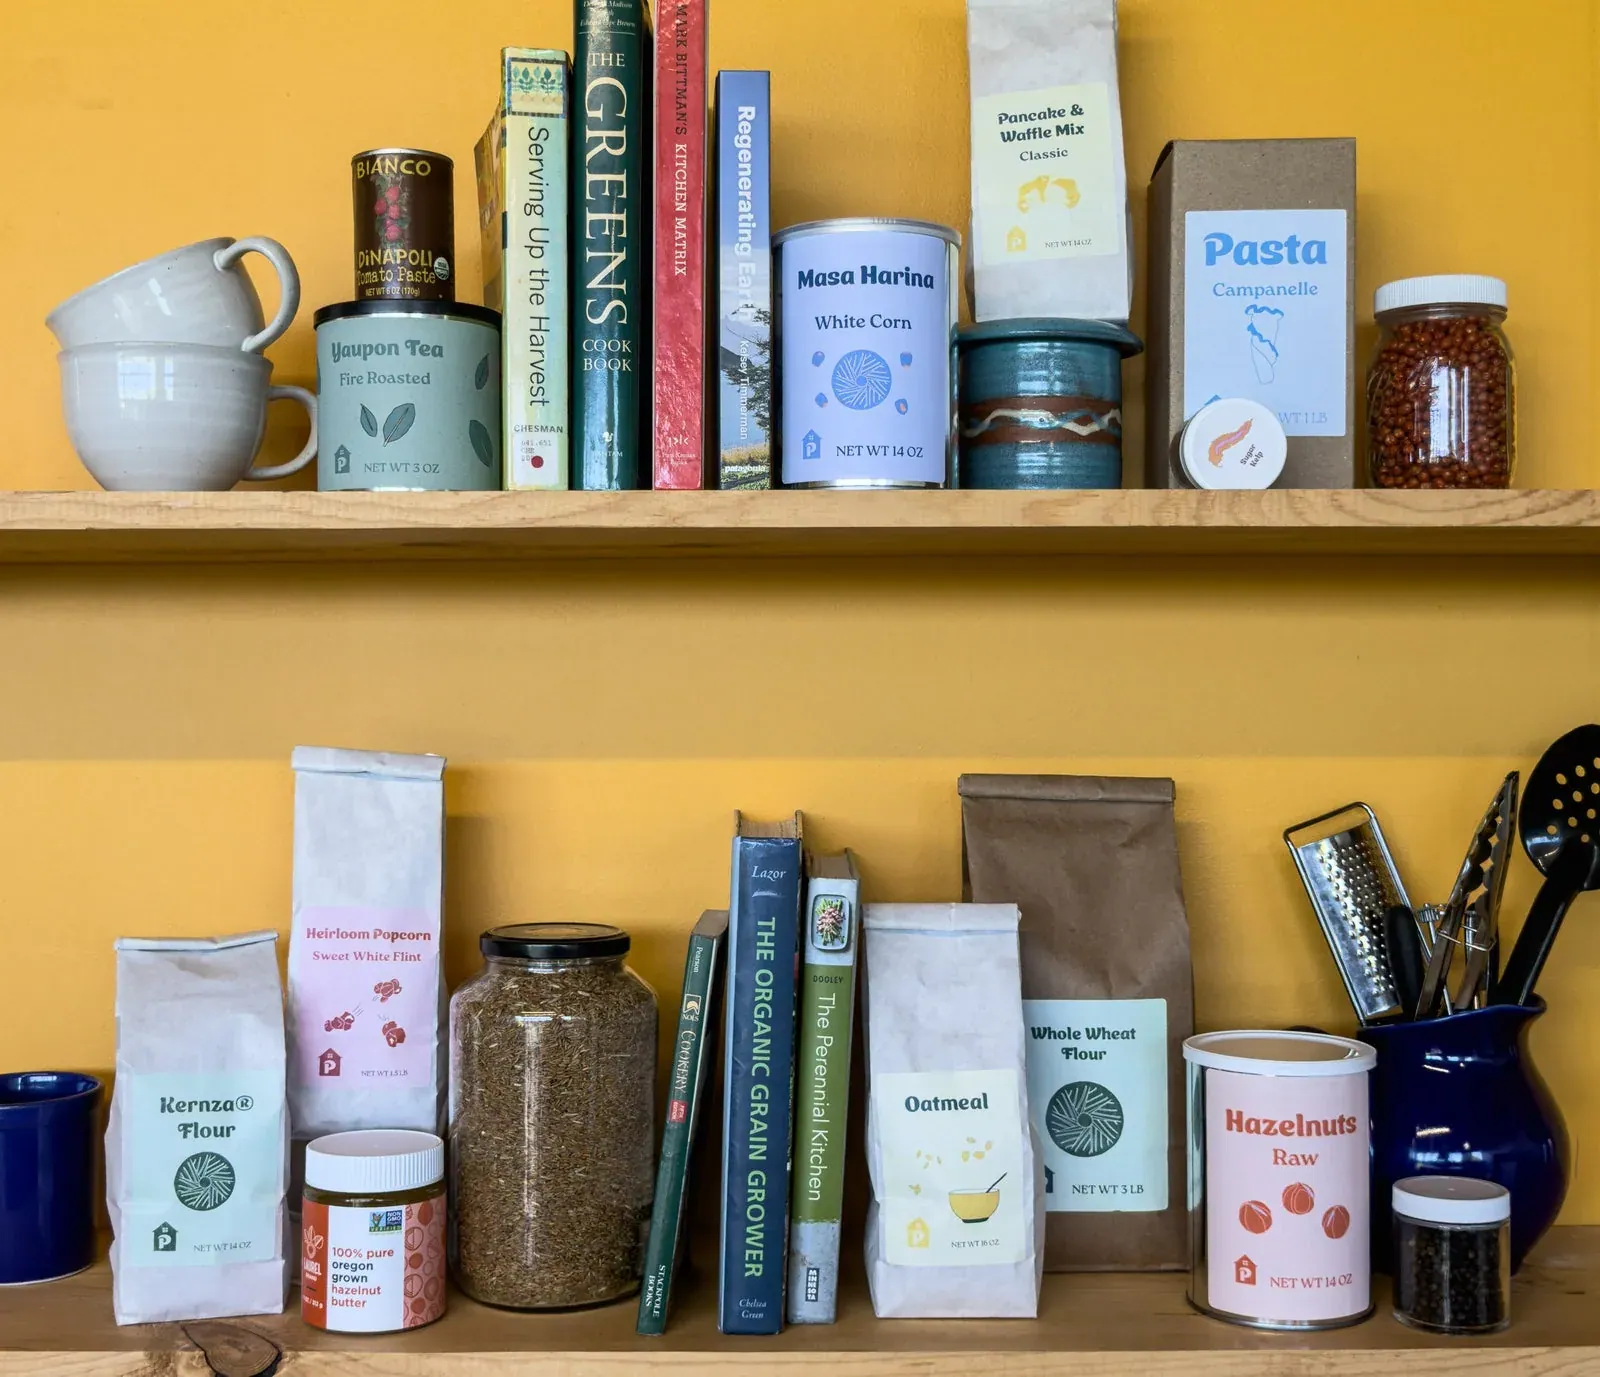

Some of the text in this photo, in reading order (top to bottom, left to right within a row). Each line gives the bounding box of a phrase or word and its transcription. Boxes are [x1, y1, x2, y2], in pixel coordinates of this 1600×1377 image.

[590, 53, 626, 67] THE
[998, 104, 1084, 125] Pancake &
[674, 4, 688, 276] MARK BITTMAN'S KITCHEN MATRIX
[1000, 123, 1085, 143] Waffle Mix
[1019, 148, 1069, 162] Classic
[357, 158, 431, 179] BIANCO
[585, 77, 628, 325] GREENS
[734, 106, 756, 322] Regenerating Earth
[1045, 241, 1059, 249] NET
[1073, 239, 1081, 247] 14
[1081, 238, 1093, 246] OZ
[1204, 232, 1327, 267] Pasta
[359, 248, 432, 270] DiNAPOLI
[524, 127, 550, 407] Serving Up the Harvest
[357, 266, 393, 286] Tomato
[397, 266, 436, 284] Paste
[798, 265, 935, 290] Masa Harina
[365, 286, 421, 298] NET WT 6 OZ (170g)
[1213, 282, 1318, 299] Campanelle
[815, 314, 913, 330] White Corn
[331, 339, 444, 363] Yaupon Tea
[583, 339, 632, 352] COOK
[583, 358, 632, 371] BOOK
[340, 371, 431, 386] Fire Roasted
[739, 341, 750, 440] Kelsey Timmerman
[1277, 412, 1301, 424] WT
[1311, 412, 1328, 424] LB
[514, 424, 564, 433] CHESMAN
[836, 445, 924, 458] NET WT 14 OZ
[1240, 443, 1256, 465] Sugar
[1250, 451, 1264, 468] Kelp
[364, 462, 440, 474] NET WT 3 OZ
[752, 866, 787, 882] Lazor
[306, 928, 432, 943] Heirloom Popcorn
[313, 951, 422, 962] Sweet White Flint
[693, 946, 704, 973] Pearson
[813, 975, 844, 984] DOOLEY
[1031, 1026, 1137, 1041] Whole Wheat
[674, 1029, 697, 1095] COOKERY
[1061, 1047, 1107, 1061] Flour
[399, 1069, 408, 1077] LB
[744, 917, 776, 1278] THE ORGANIC GRAIN GROWER
[808, 993, 836, 1201] The Perennial Kitchen
[904, 1092, 989, 1113] Oatmeal
[178, 1122, 236, 1139] Flour
[1225, 1108, 1357, 1137] Hazelnuts
[1272, 1148, 1319, 1166] Raw
[1072, 1184, 1145, 1195] NET WT 3 LB
[386, 1210, 401, 1218] NON
[193, 1241, 252, 1252] NET WT 14 OZ
[951, 1238, 1000, 1249] NET WT 16 OZ
[332, 1247, 394, 1260] 100% pure
[332, 1260, 374, 1275] oregon
[331, 1273, 368, 1284] grown
[1270, 1273, 1353, 1289] NET WT 14 OZ
[331, 1284, 382, 1296] hazelnut
[645, 1275, 656, 1307] BOOKS
[652, 1265, 666, 1318] STACKPOLE
[331, 1296, 367, 1309] butter
[739, 1298, 767, 1308] Chelsea
[741, 1309, 764, 1319] Green
